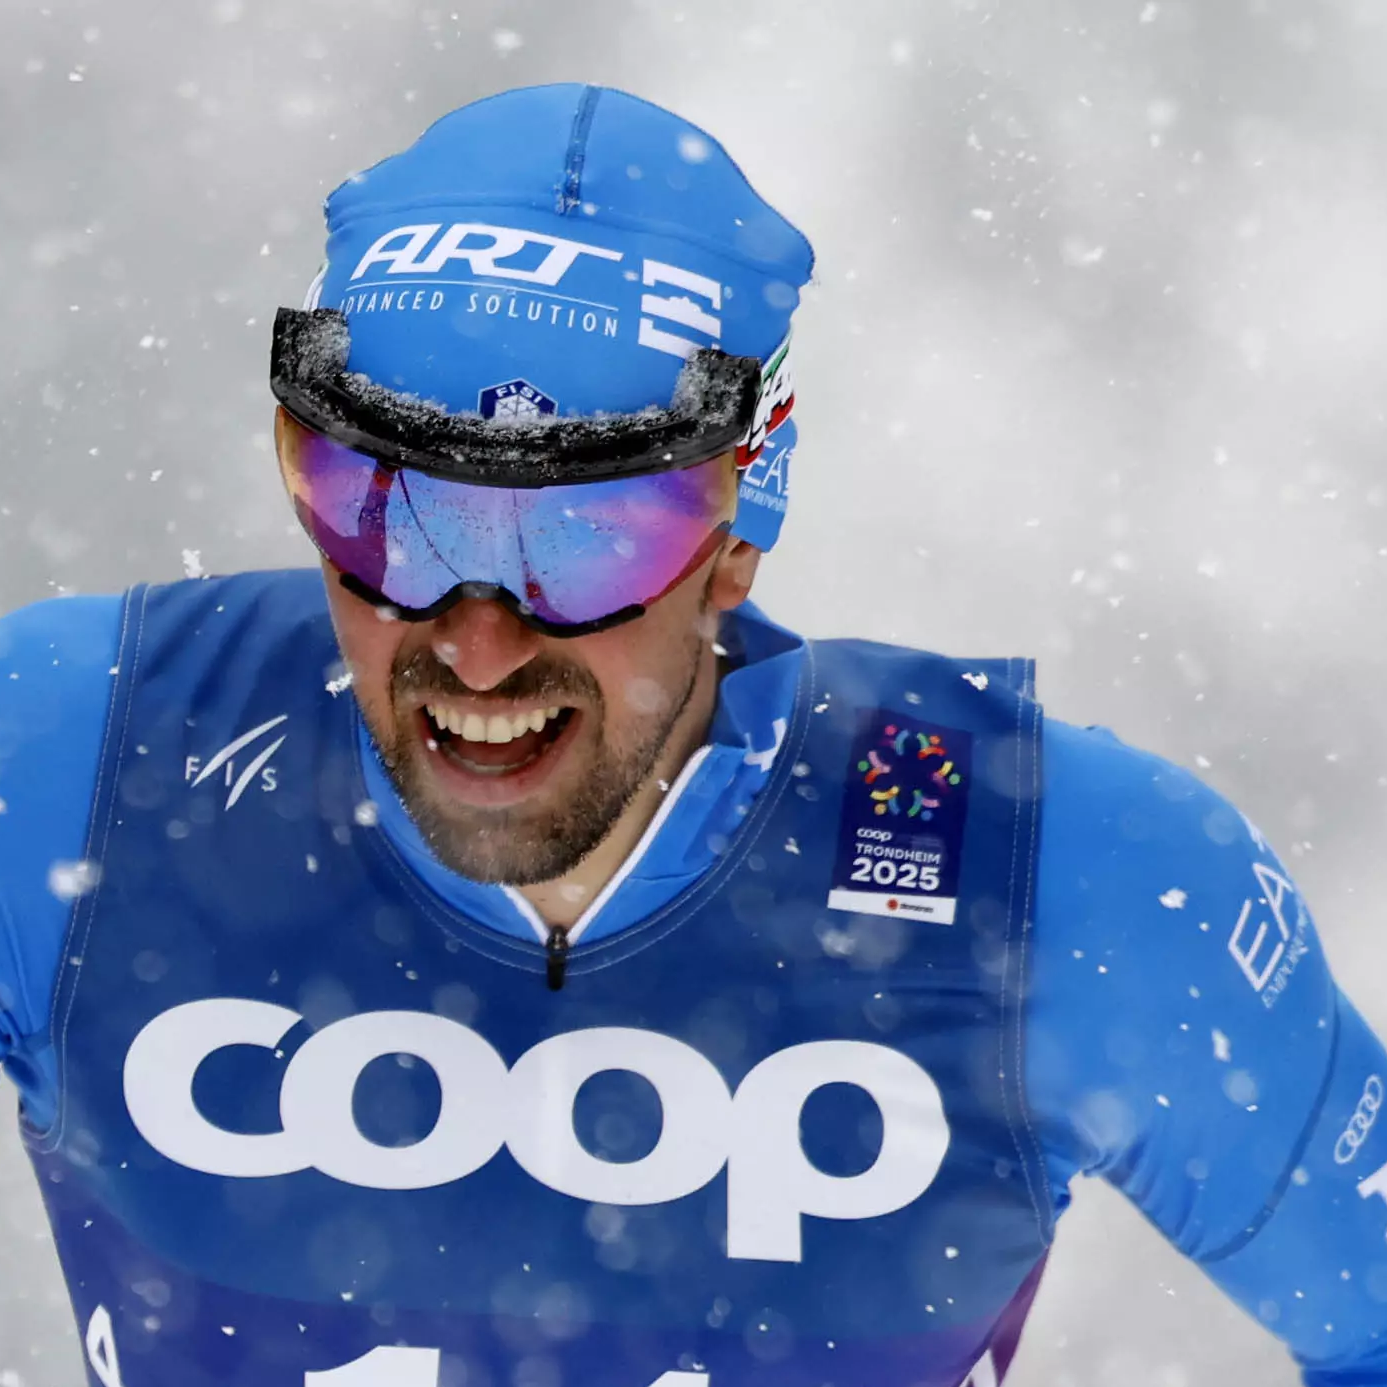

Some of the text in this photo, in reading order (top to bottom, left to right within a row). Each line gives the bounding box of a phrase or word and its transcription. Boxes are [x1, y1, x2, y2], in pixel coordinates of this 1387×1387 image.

[350, 223, 624, 287] ART
[467, 292, 619, 338] SOLUTION
[495, 384, 543, 404] FISI
[743, 441, 790, 496] EA
[855, 843, 941, 865] TRONDHEIM
[856, 828, 892, 842] coop
[850, 857, 940, 891] 2025
[1228, 828, 1295, 993] EA
[123, 998, 950, 1263] coop
